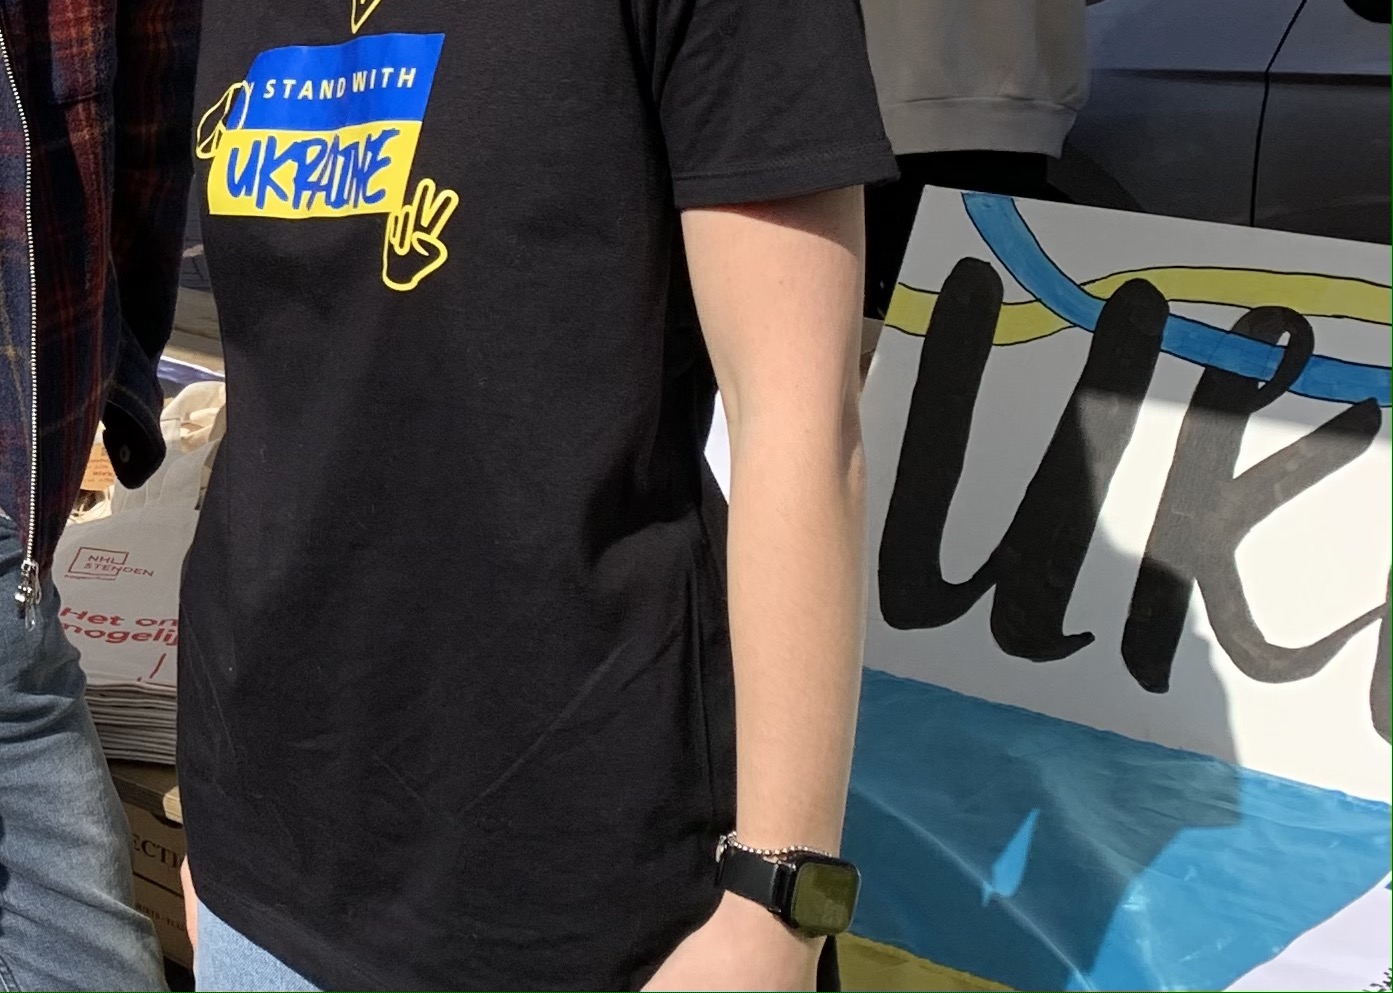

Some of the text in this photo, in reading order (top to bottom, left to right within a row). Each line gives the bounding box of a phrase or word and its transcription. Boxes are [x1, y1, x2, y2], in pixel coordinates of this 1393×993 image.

[263, 78, 347, 101] STAND
[352, 67, 417, 94] WITH
[226, 128, 401, 210] UKRAINE
[83, 563, 154, 577] STENDEN
[61, 607, 125, 626] Het
